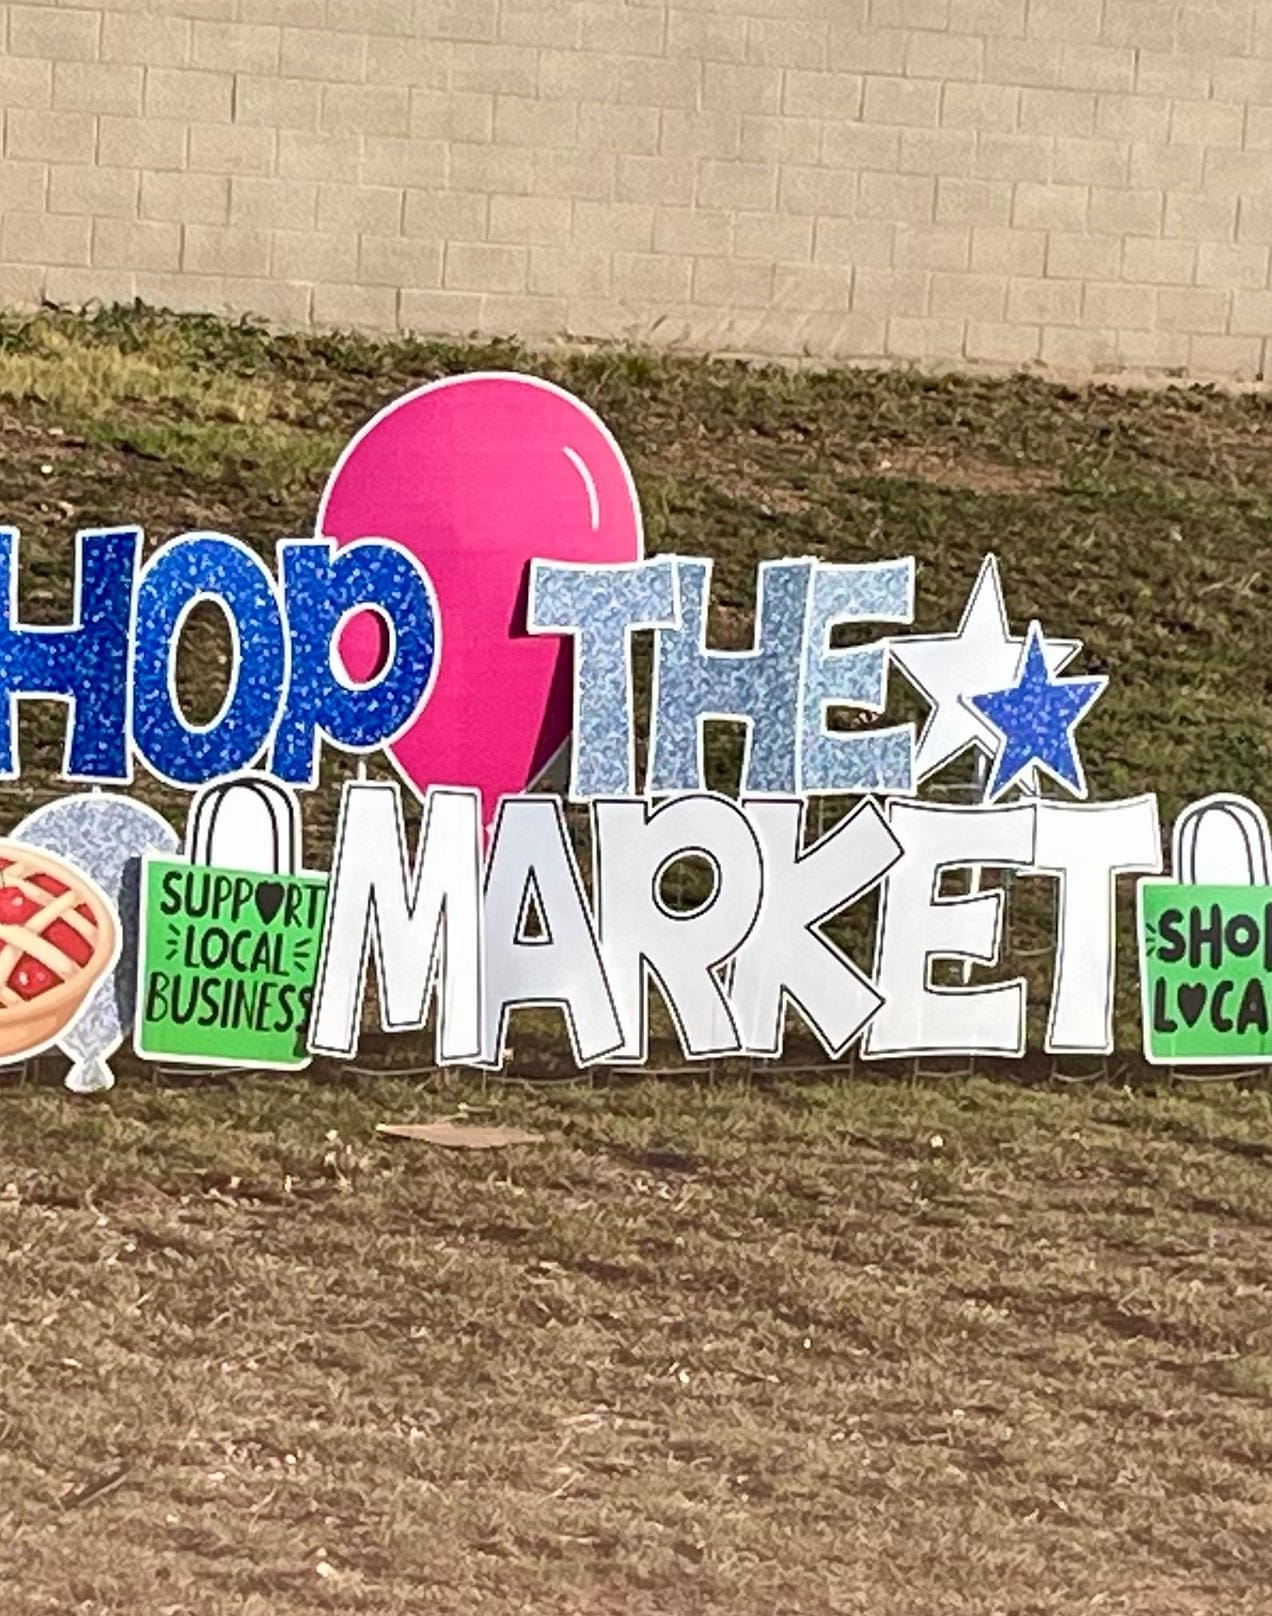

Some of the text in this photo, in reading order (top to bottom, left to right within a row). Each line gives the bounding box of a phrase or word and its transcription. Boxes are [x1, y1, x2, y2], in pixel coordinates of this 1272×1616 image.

[529, 556, 914, 795] THE
[185, 925, 290, 976] LOCAL
[311, 780, 1158, 1062] MARKET
